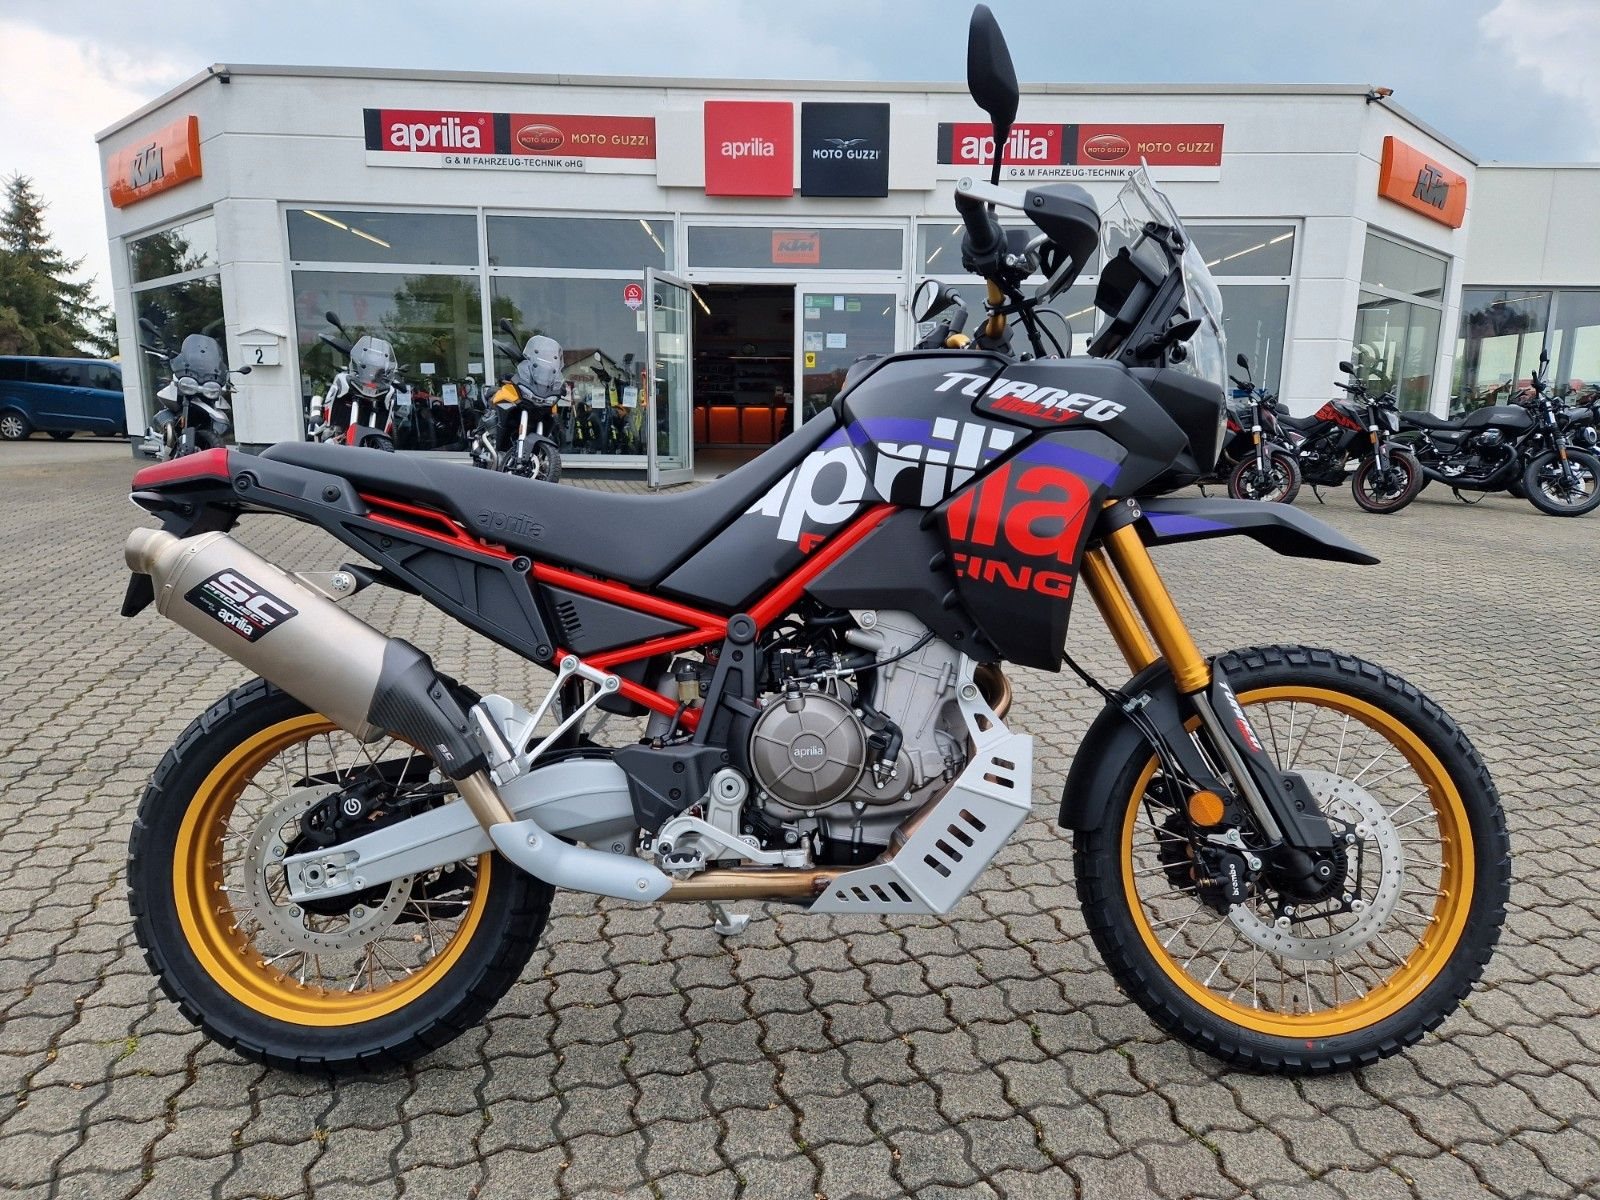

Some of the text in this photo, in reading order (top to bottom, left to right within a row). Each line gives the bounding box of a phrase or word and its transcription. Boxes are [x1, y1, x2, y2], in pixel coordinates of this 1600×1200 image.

[390, 117, 481, 151] aprilia
[571, 133, 649, 146] MOTO GUZZI
[721, 137, 774, 159] aprilia
[812, 149, 879, 160] MOTO GUZZI
[1137, 142, 1214, 153] MOTO GUZZI
[445, 156, 452, 164] G
[454, 156, 460, 164] &
[472, 157, 562, 168] FAHRZEUG-TECHNIK
[1010, 168, 1017, 176] G
[1019, 168, 1026, 176] &
[1028, 168, 1035, 176] M
[1037, 168, 1125, 177] FAHRZEUG-TECHNIK
[1412, 163, 1449, 211] KTM
[255, 348, 264, 364] 2
[476, 508, 545, 541] aprilia
[203, 583, 271, 626] PROJECT
[208, 573, 290, 623] SC
[217, 608, 254, 636] aprilia
[793, 745, 823, 758] aprilia
[1229, 863, 1240, 896] brembo
